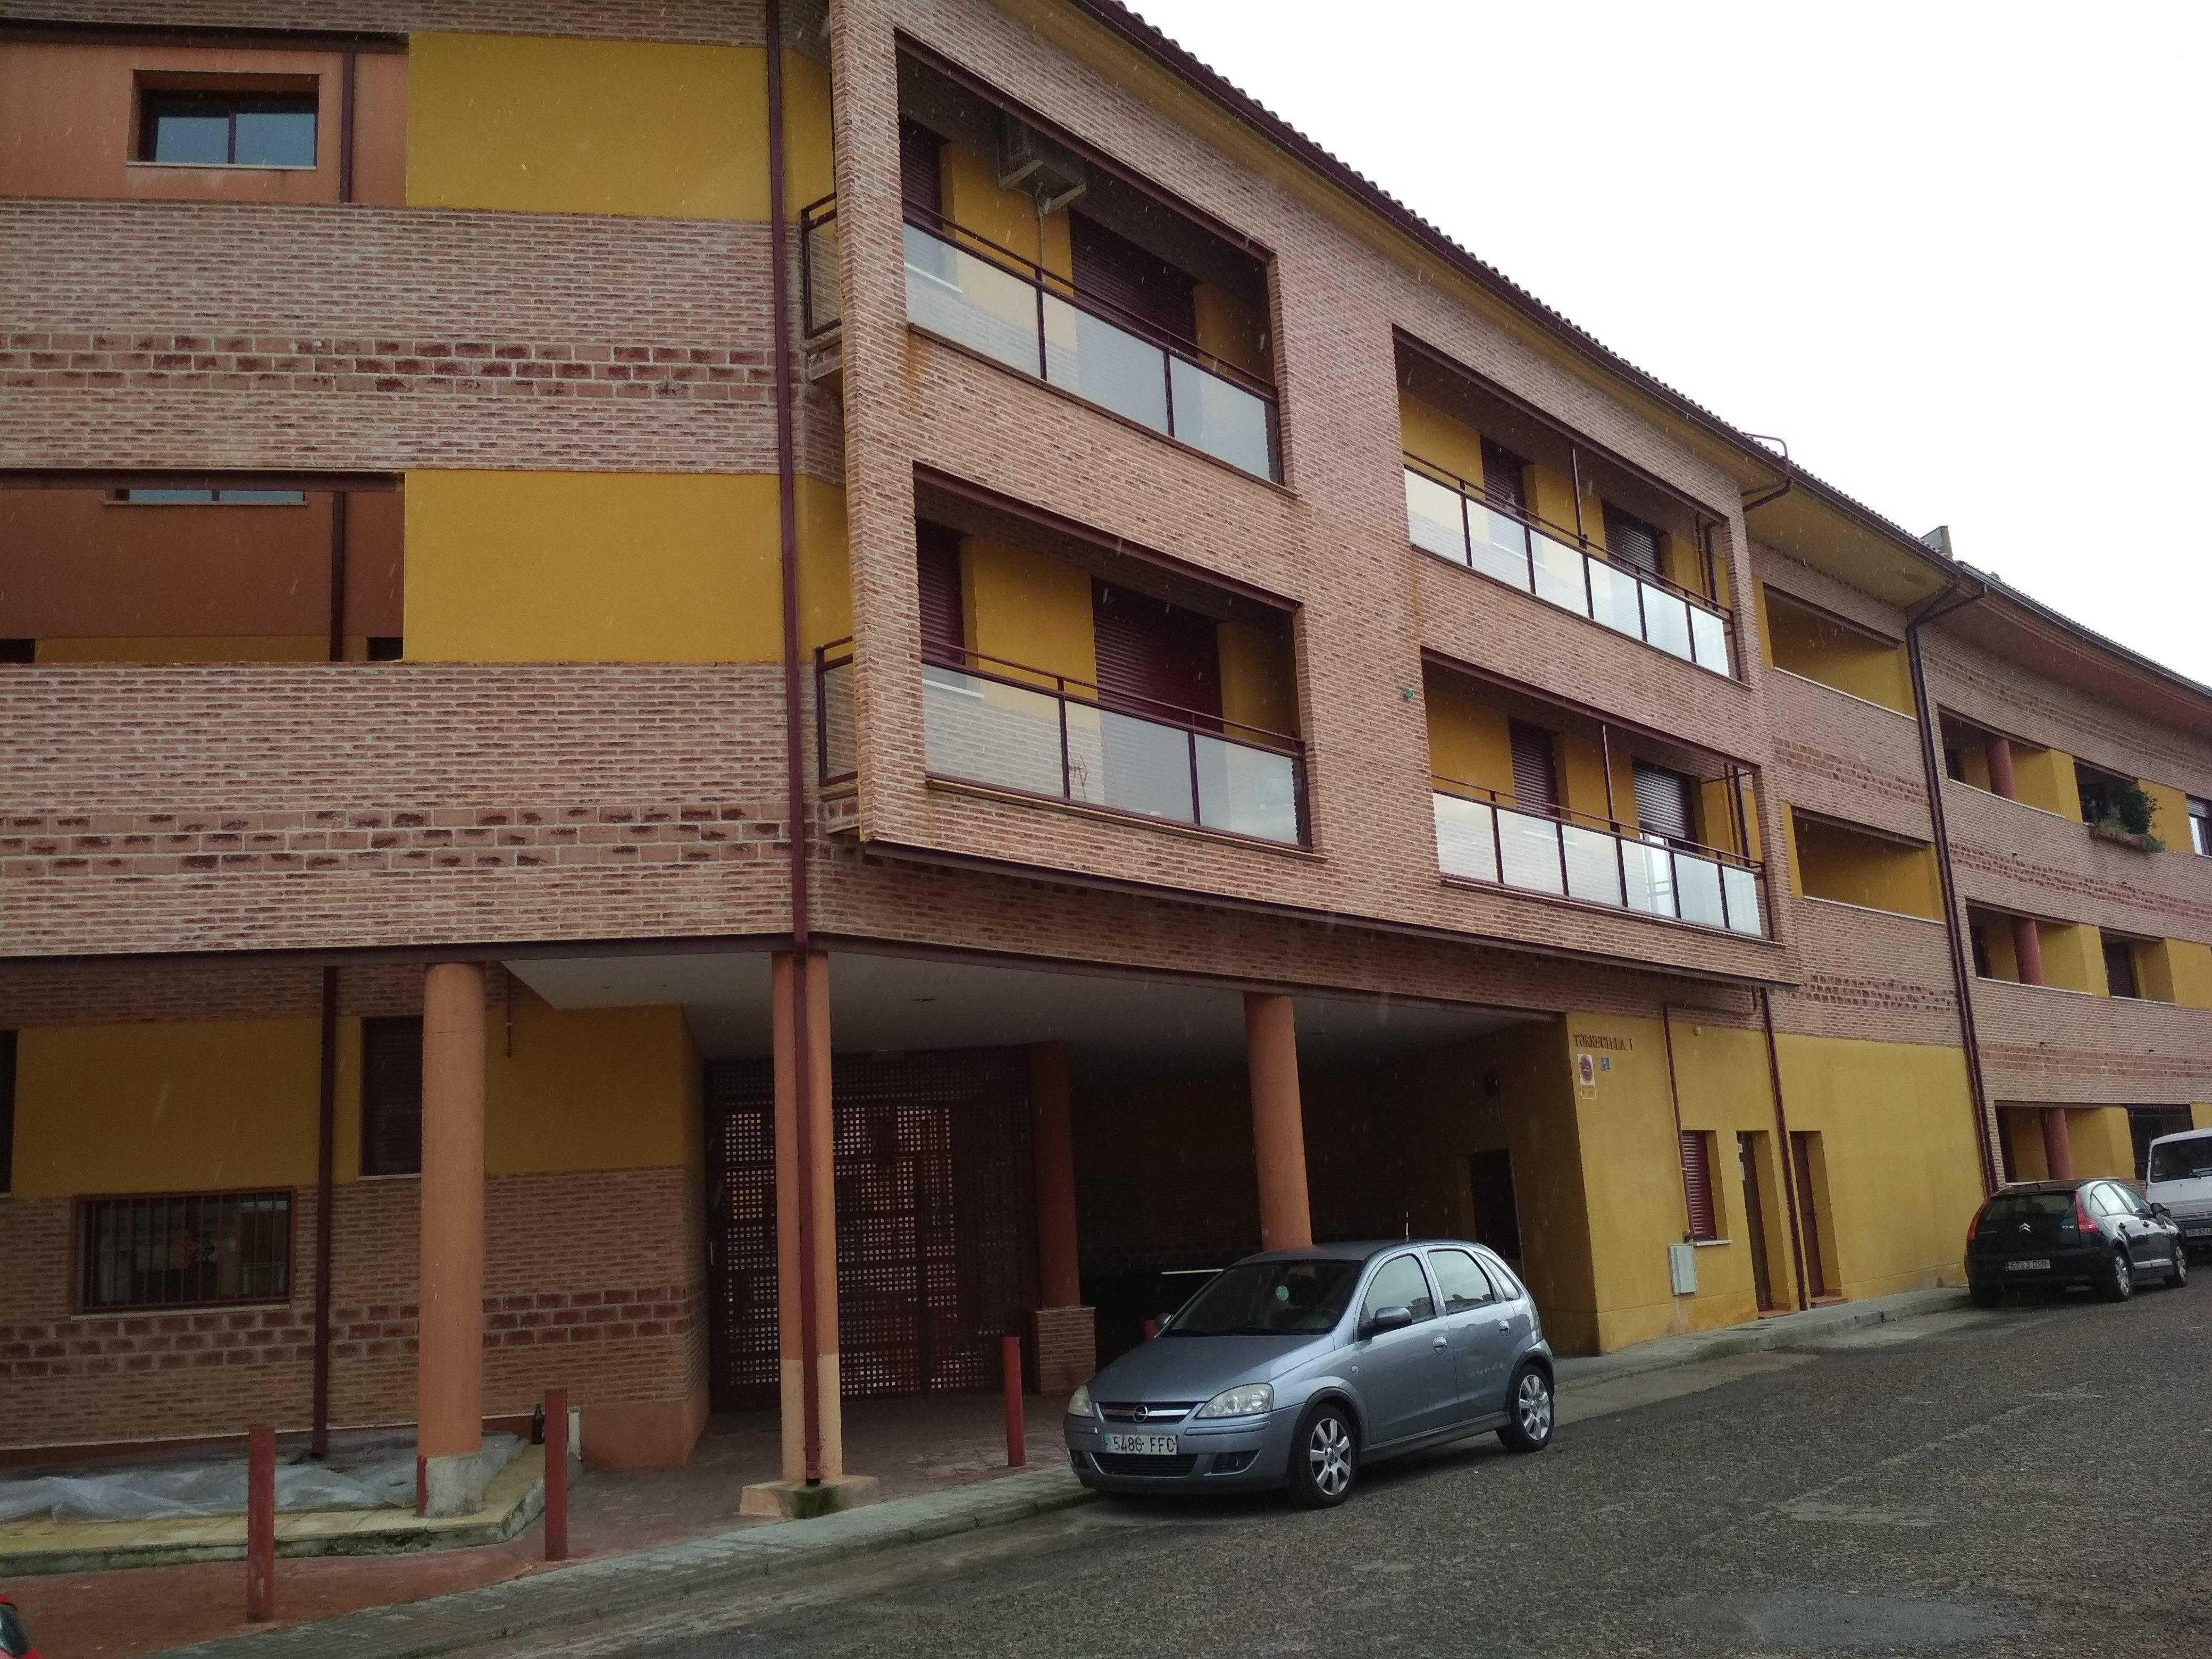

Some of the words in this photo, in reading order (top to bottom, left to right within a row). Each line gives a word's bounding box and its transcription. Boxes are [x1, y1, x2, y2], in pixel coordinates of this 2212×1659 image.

[1574, 1034, 1627, 1051] TORRECILLA
[1113, 1436, 1143, 1452] 5486
[1150, 1437, 1175, 1452] FFC
